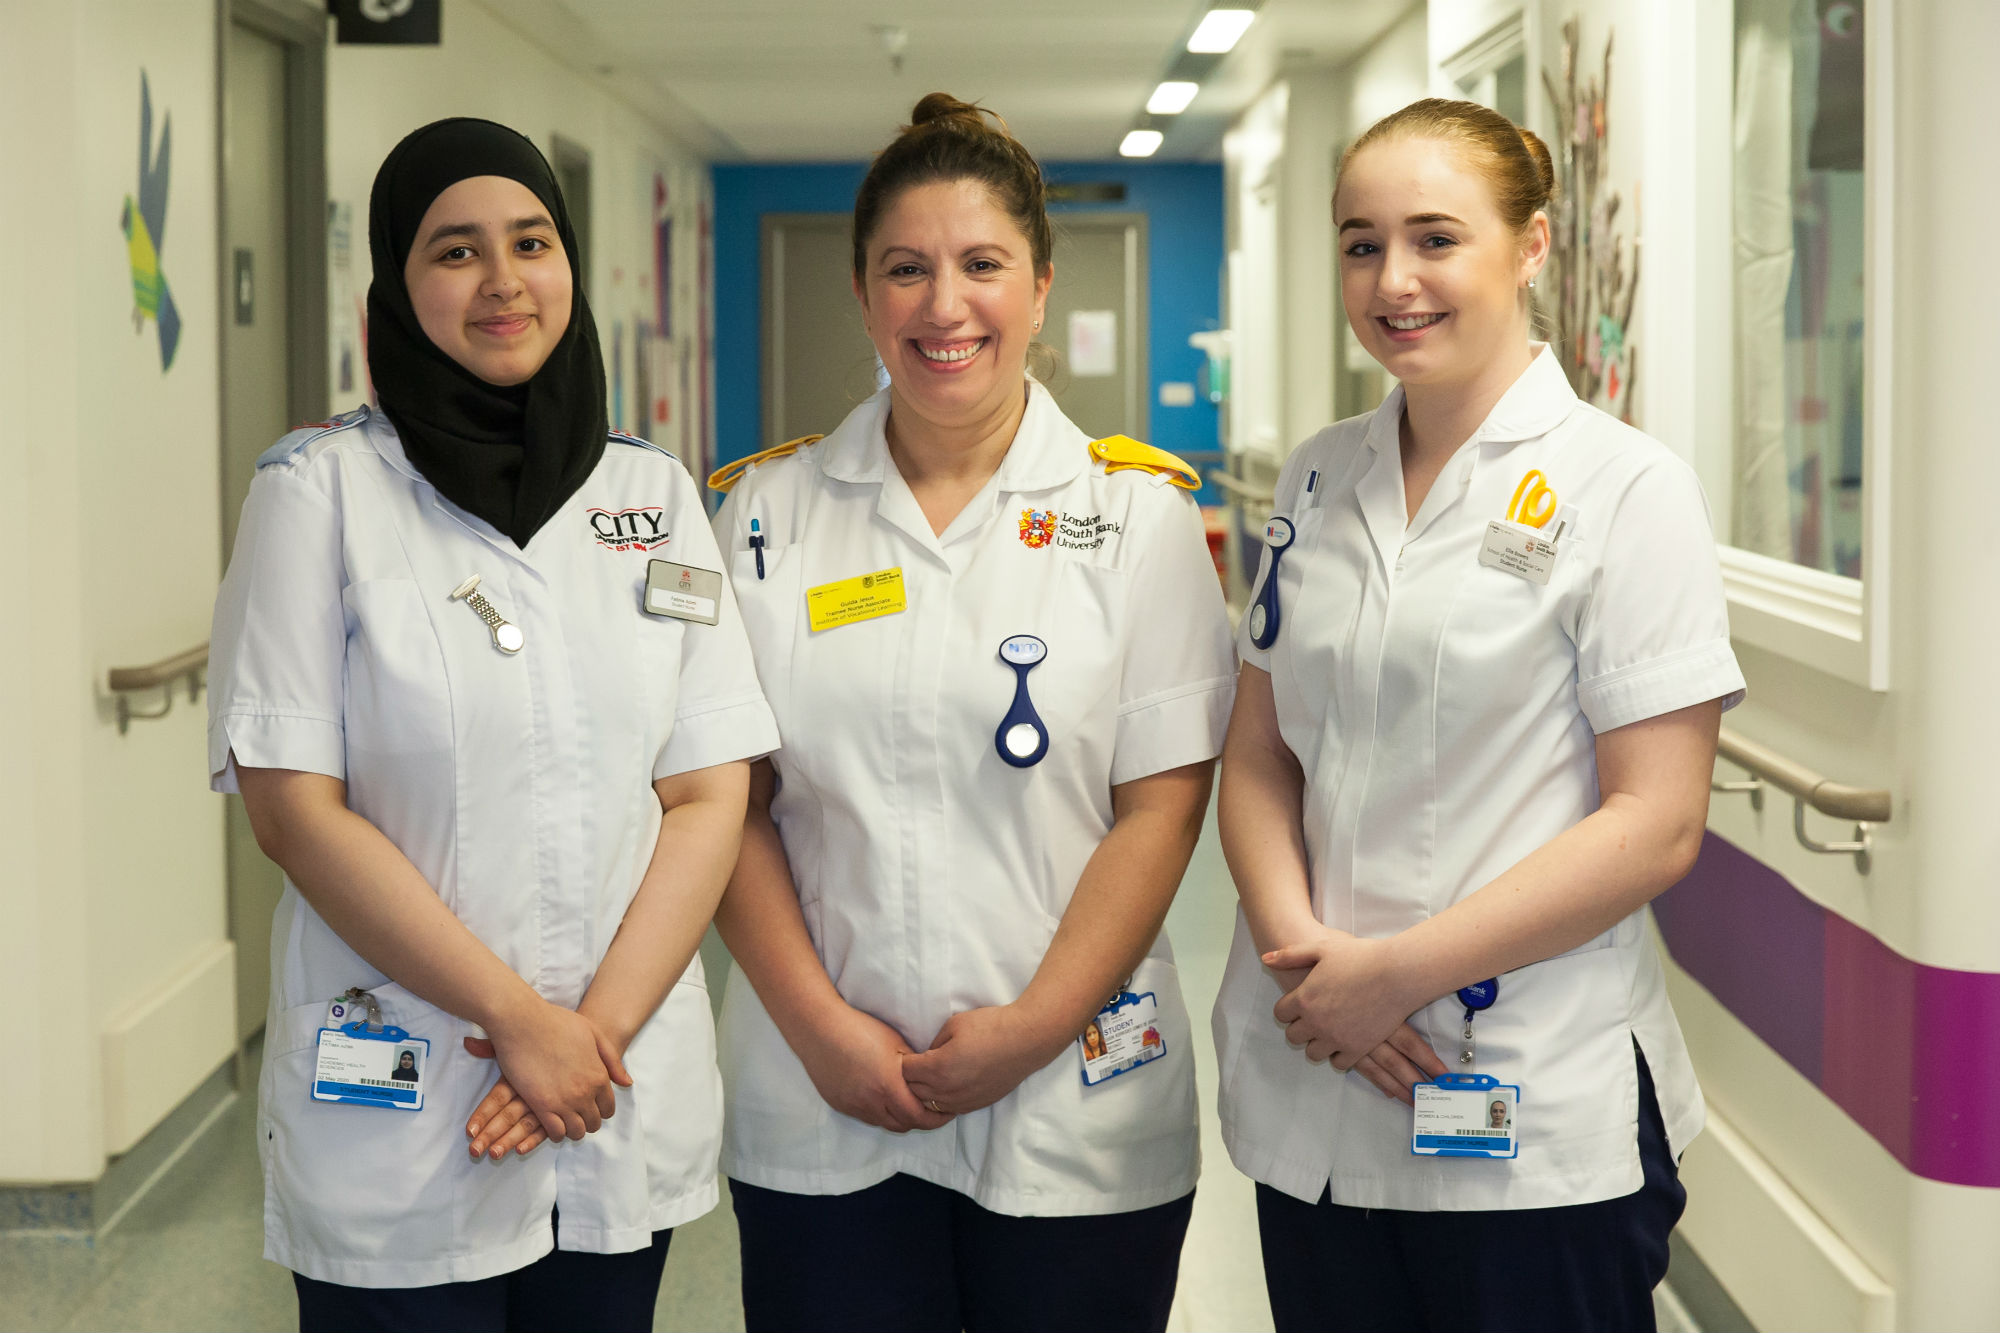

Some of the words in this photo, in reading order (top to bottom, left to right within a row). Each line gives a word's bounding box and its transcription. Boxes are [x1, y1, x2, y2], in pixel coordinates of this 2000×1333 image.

[590, 511, 663, 537] CITY
[1062, 512, 1101, 527] London
[1059, 524, 1093, 538] South
[1095, 522, 1121, 535] Bank
[595, 533, 630, 545] UNIVERSITY
[640, 532, 668, 544] LONDON
[1056, 536, 1105, 550] University
[616, 544, 630, 552] EST
[865, 598, 891, 608] Associate
[1103, 1018, 1134, 1036] STUDENT
[339, 1087, 370, 1095] STUDENT
